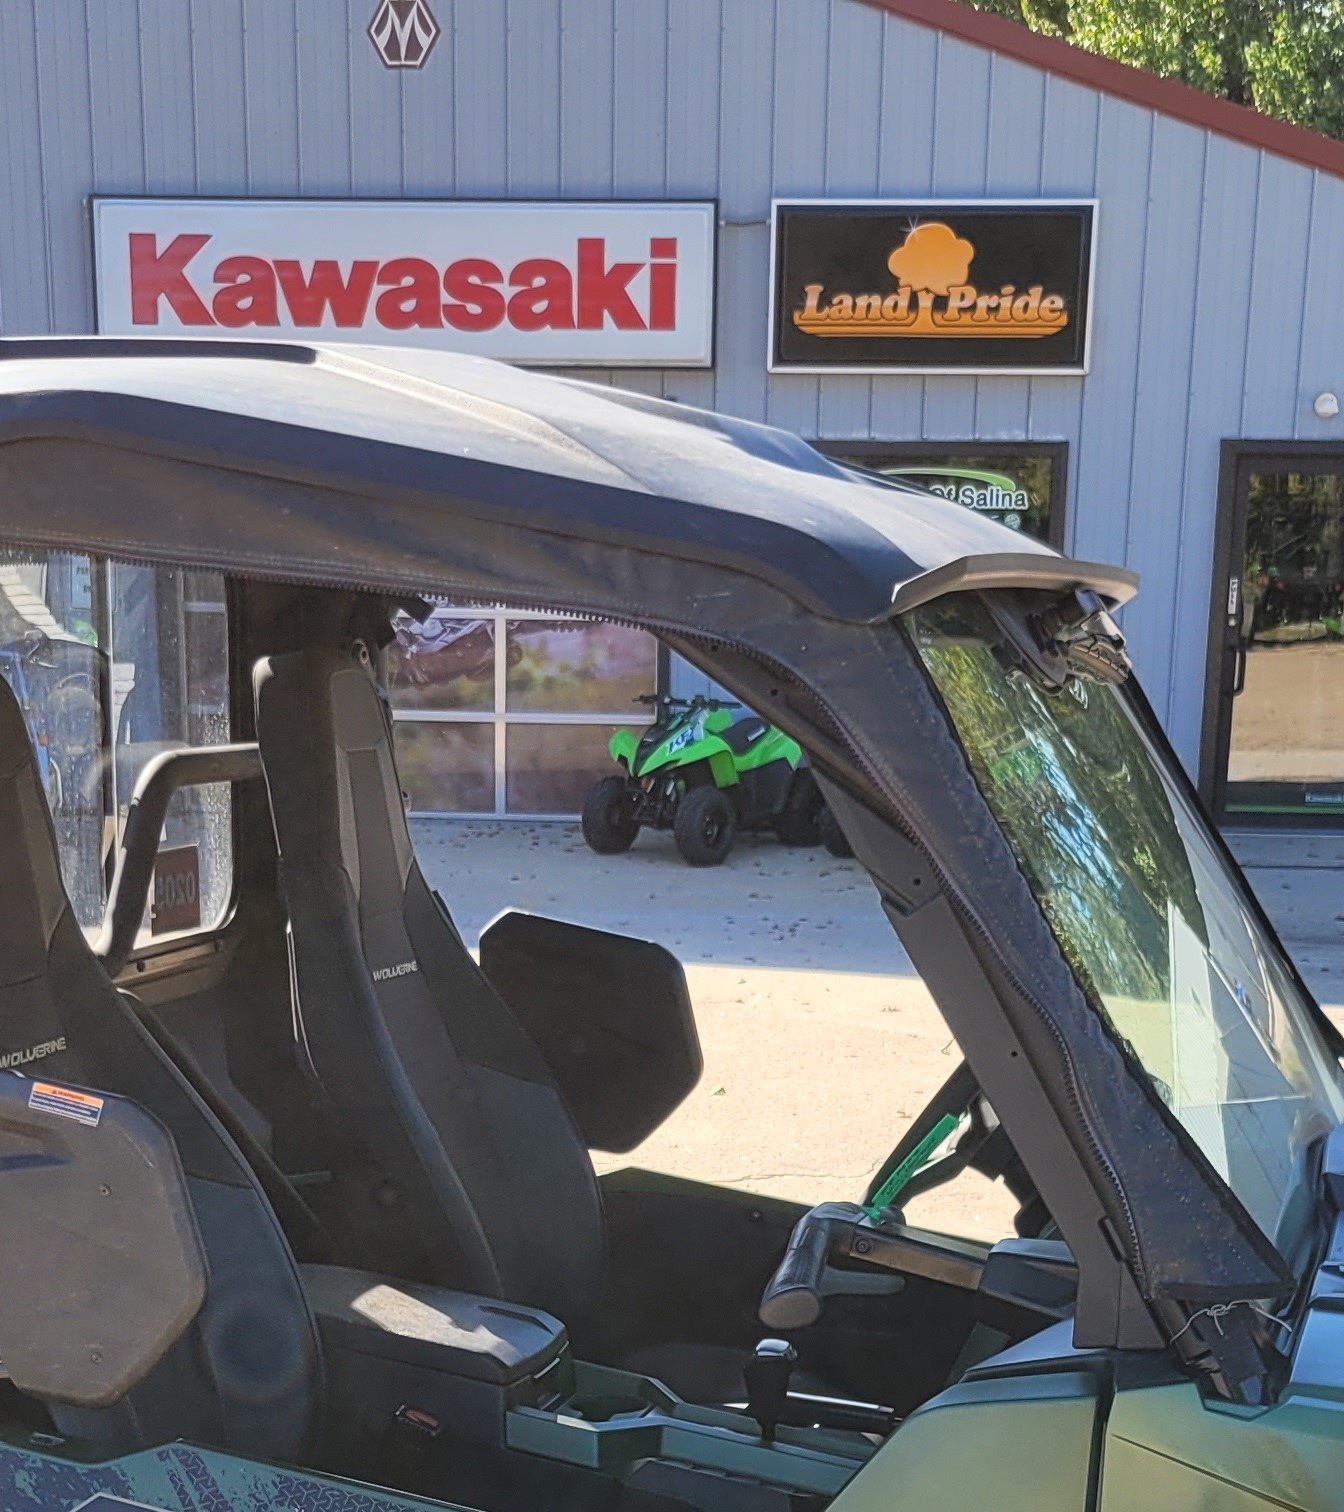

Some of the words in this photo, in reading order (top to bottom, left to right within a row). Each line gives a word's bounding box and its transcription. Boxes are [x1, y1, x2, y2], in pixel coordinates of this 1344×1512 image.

[128, 232, 678, 332] Kawasaki
[799, 284, 912, 322] Land
[942, 284, 1065, 322] Pride
[958, 484, 1029, 510] Salina
[372, 959, 418, 982] WOLVERINE
